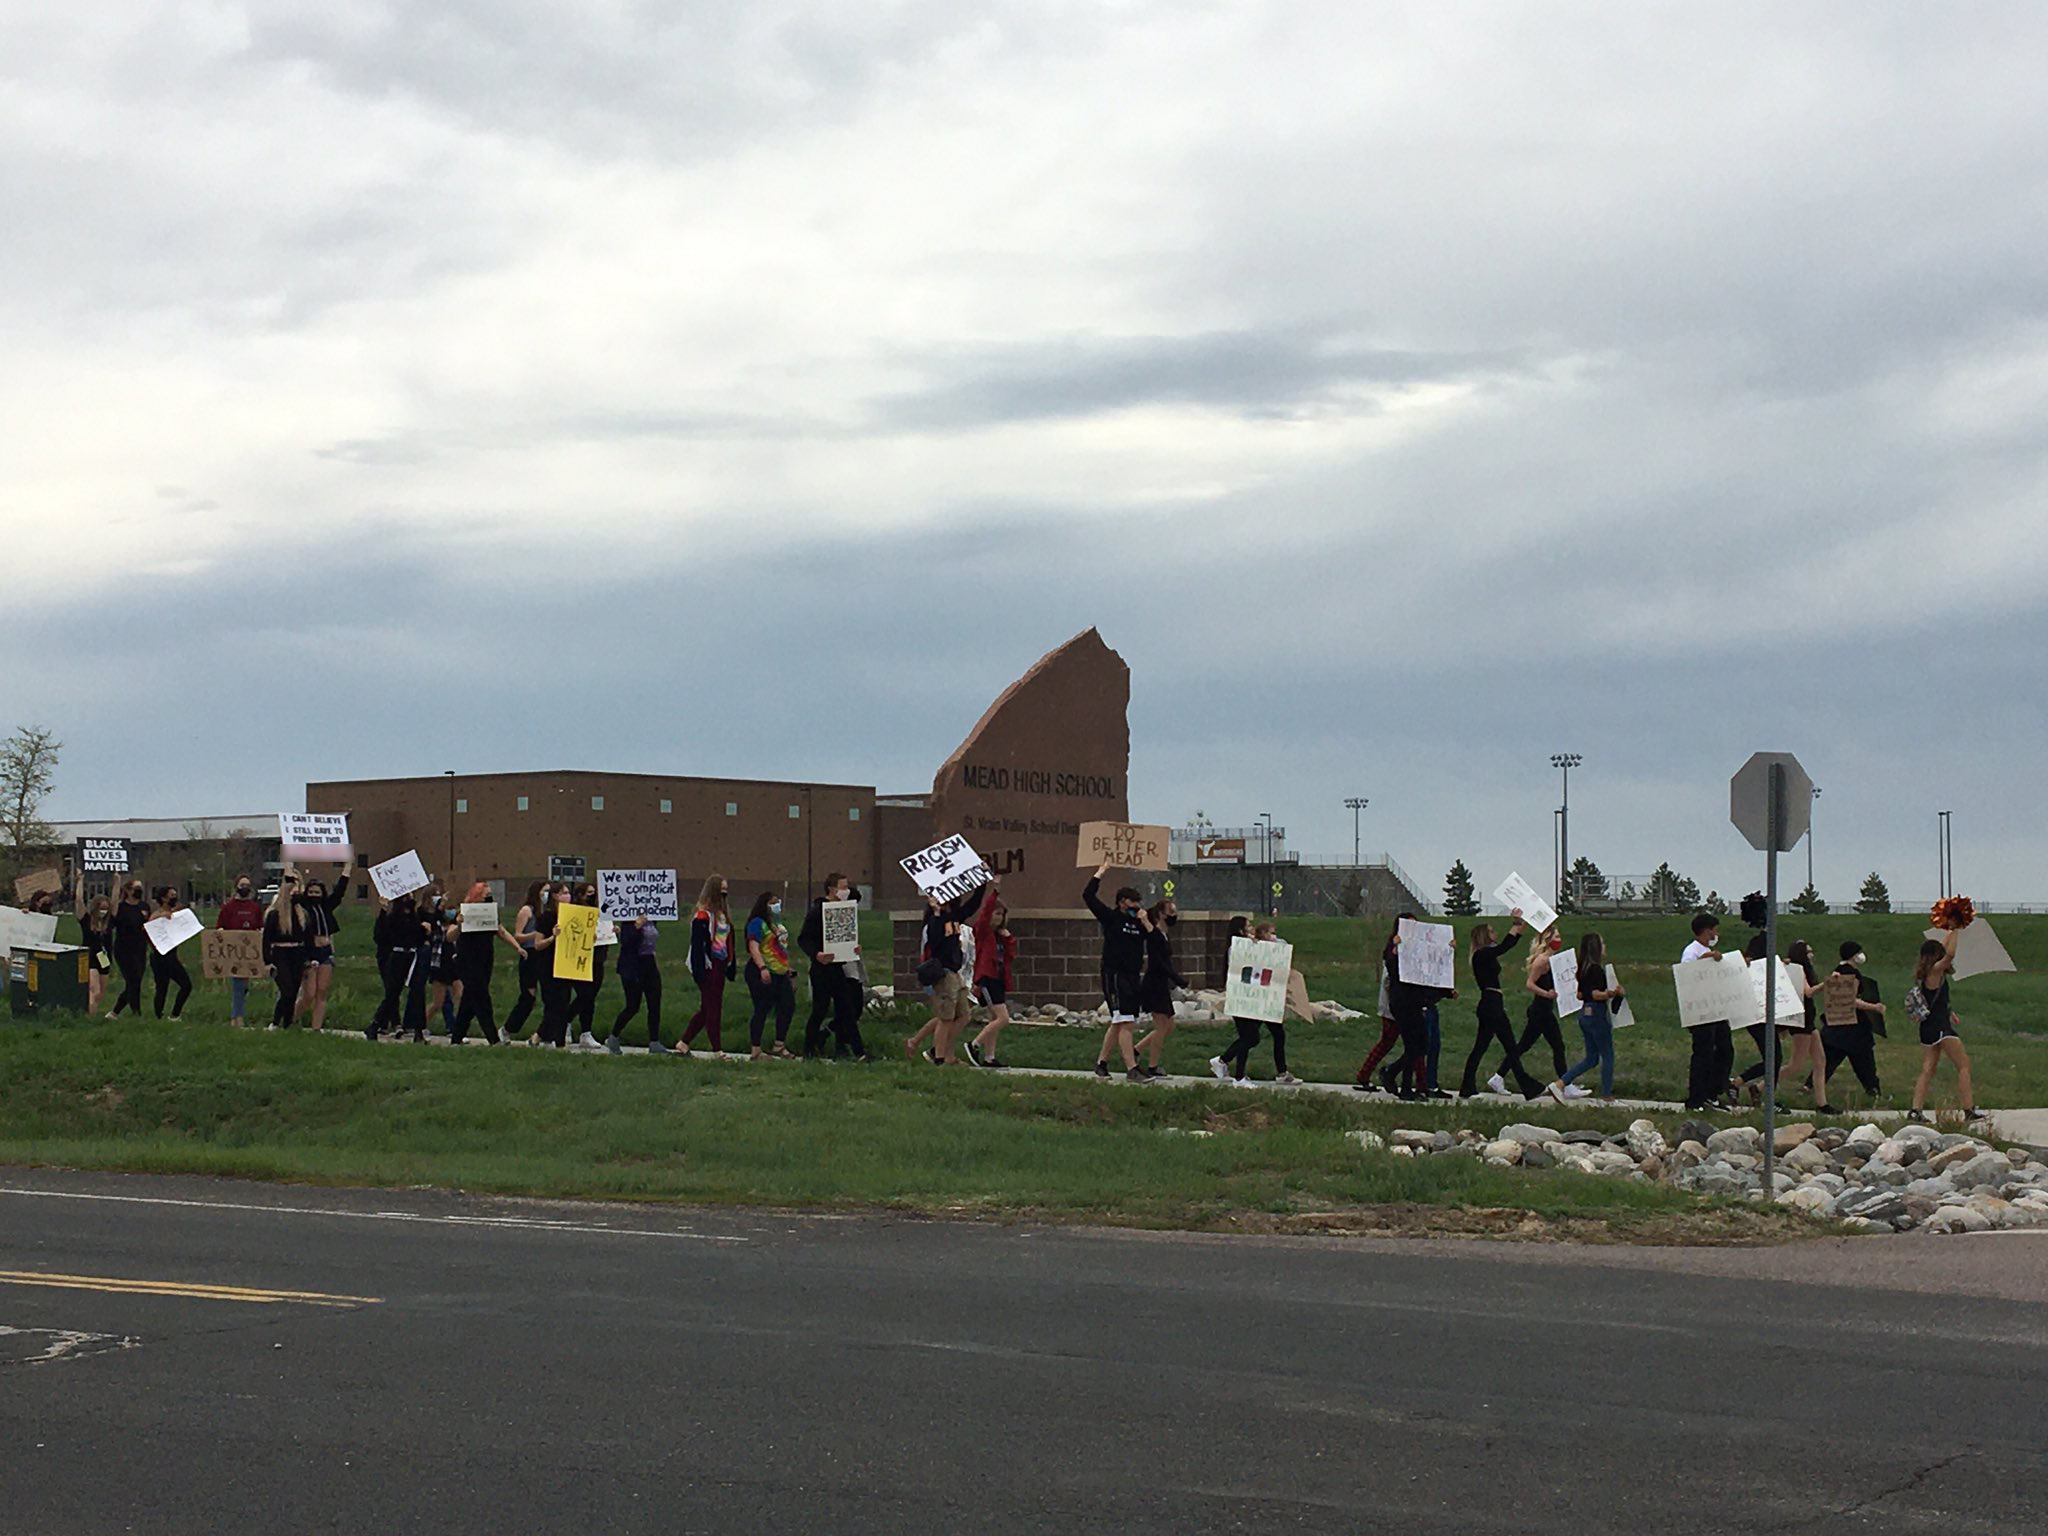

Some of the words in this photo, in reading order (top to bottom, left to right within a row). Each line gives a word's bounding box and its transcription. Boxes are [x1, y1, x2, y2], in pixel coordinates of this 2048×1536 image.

[964, 765, 1010, 790] MEAD
[1013, 769, 1050, 794] HIGH
[1055, 773, 1115, 799] SCHOOL
[314, 816, 341, 825] BELIEVE
[1002, 818, 1028, 834] Valley
[1029, 819, 1060, 834] School
[334, 827, 344, 835] TO
[85, 840, 123, 849] BLACK
[292, 836, 323, 844] PROTEST
[1093, 837, 1159, 857] BETTER
[88, 851, 122, 860] LIVES
[903, 837, 966, 876] RACISM
[1104, 851, 1142, 866] MEAD
[84, 862, 129, 872] MATTER
[602, 871, 622, 883] We
[625, 870, 646, 882] will
[648, 870, 668, 882] not
[605, 884, 620, 897] be
[626, 882, 674, 896] complicit
[618, 895, 630, 908] by
[634, 895, 661, 908] being
[612, 900, 677, 918] complacent
